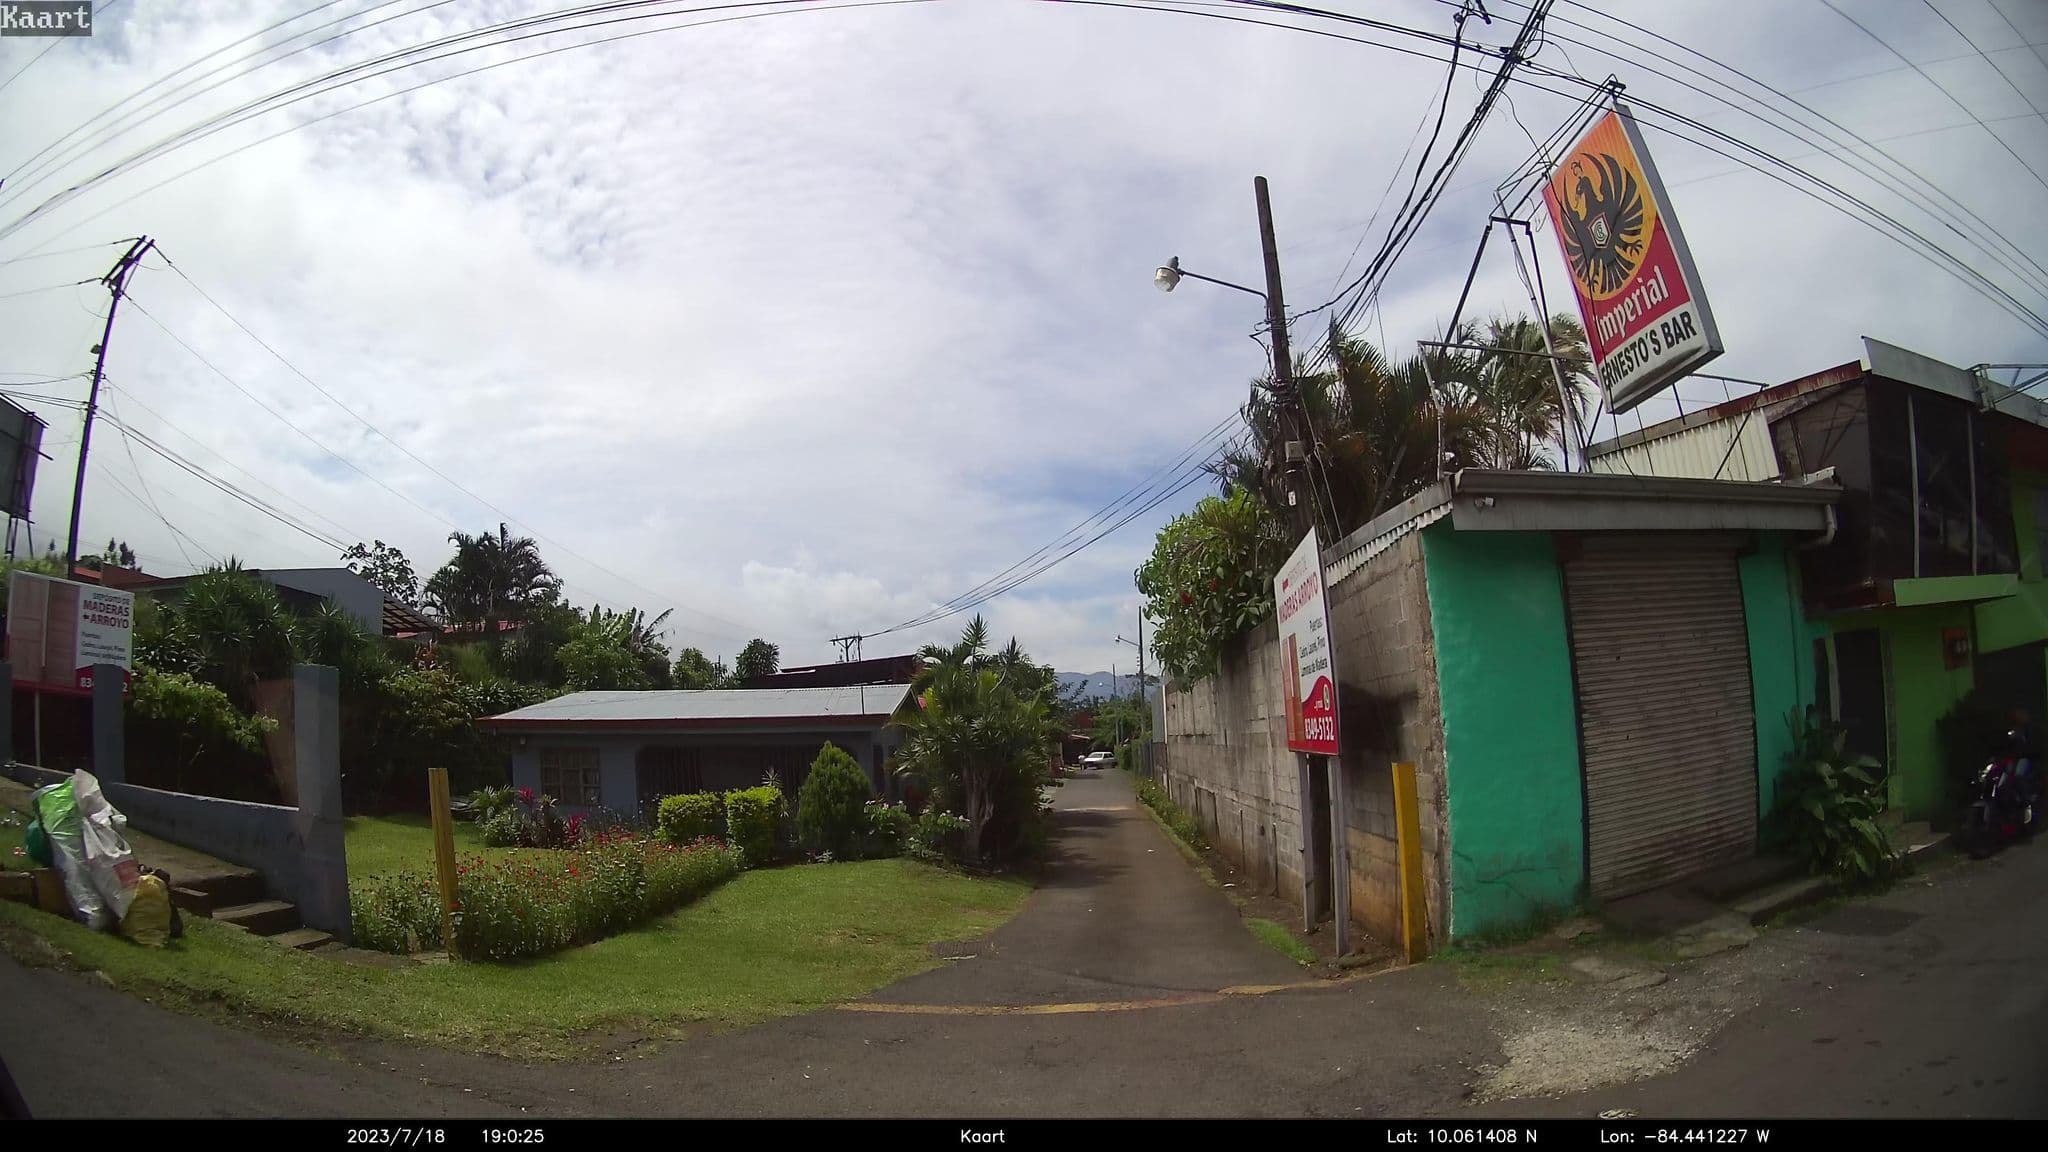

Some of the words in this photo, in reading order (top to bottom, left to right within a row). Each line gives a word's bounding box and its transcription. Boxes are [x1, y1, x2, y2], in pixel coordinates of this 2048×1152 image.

[1593, 265, 1669, 346] Imperial
[1660, 311, 1697, 349] BAR
[83, 600, 129, 617] MADERAS
[89, 613, 129, 629] ARROYO
[1304, 716, 1335, 741] 8349-5132
